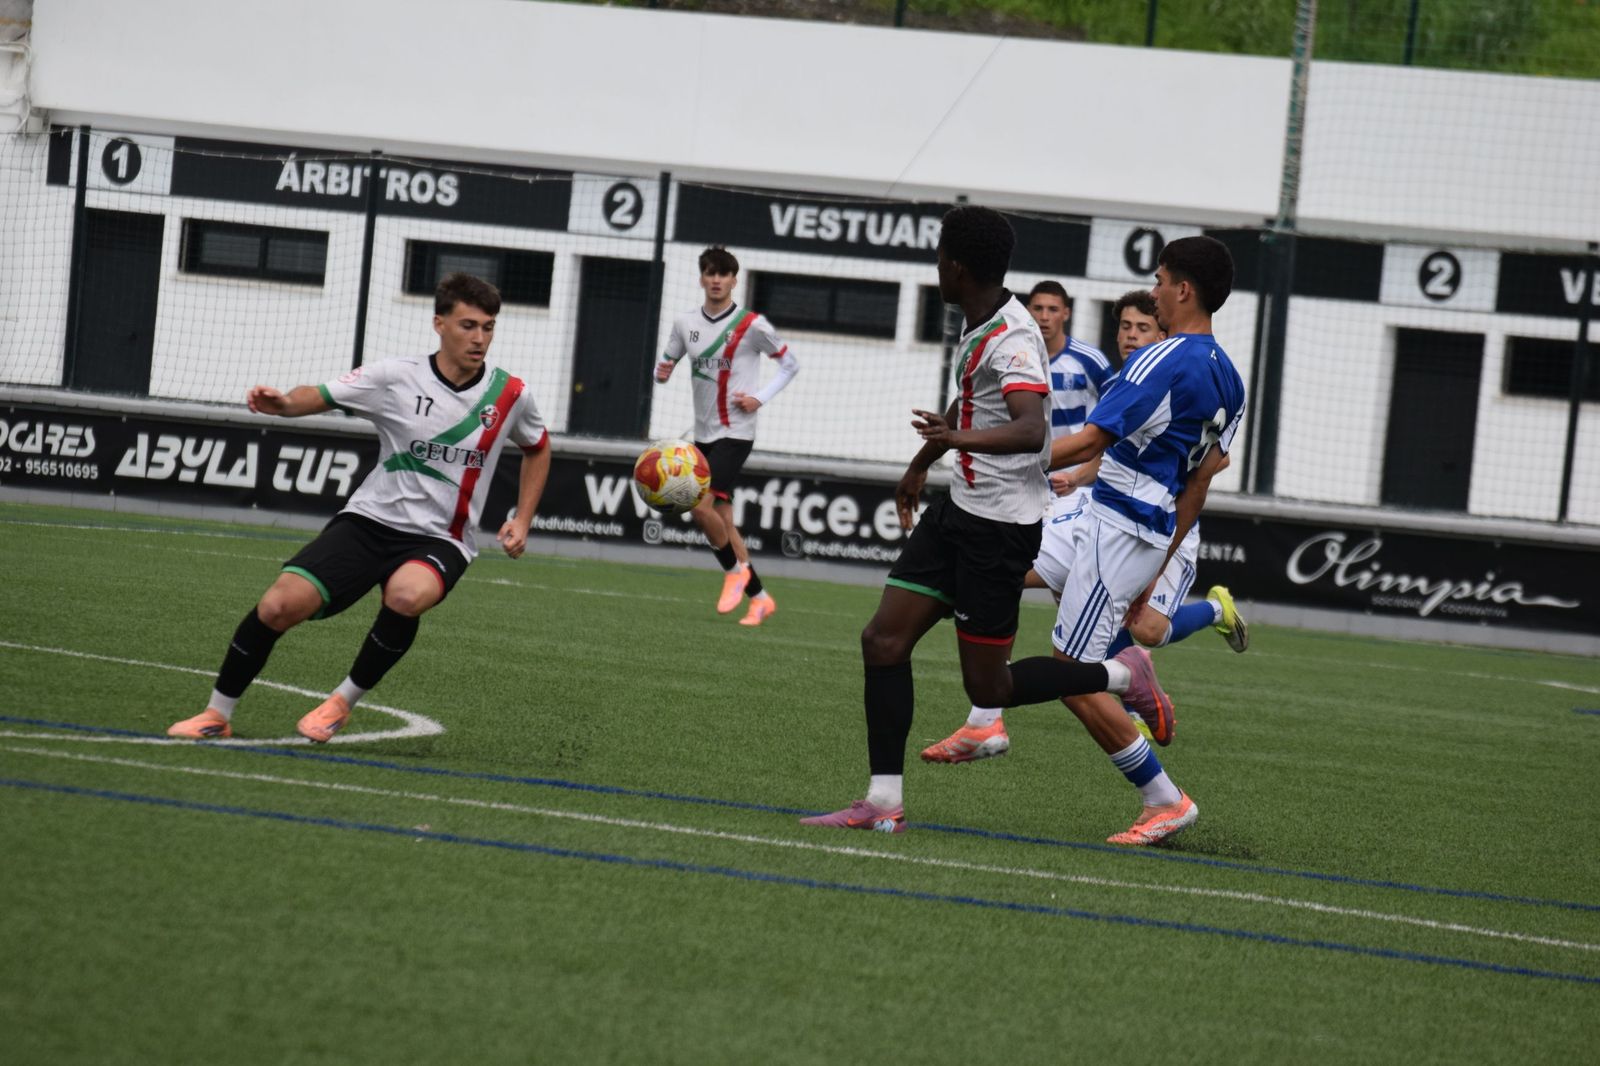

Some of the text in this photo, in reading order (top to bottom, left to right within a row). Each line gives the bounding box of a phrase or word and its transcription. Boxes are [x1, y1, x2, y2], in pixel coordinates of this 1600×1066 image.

[111, 142, 129, 179] 1
[275, 152, 459, 206] ÁRBIROS
[610, 189, 634, 224] 2
[770, 203, 941, 250] VESTUAR
[1133, 232, 1154, 271] 1
[1424, 258, 1454, 295] 2
[689, 331, 699, 343] 18
[415, 395, 434, 417] 17
[25, 459, 99, 480] 956510695
[114, 433, 360, 497] ABYLA TUR
[409, 439, 486, 468] CEUTA
[1286, 531, 1580, 617] Olimpia
